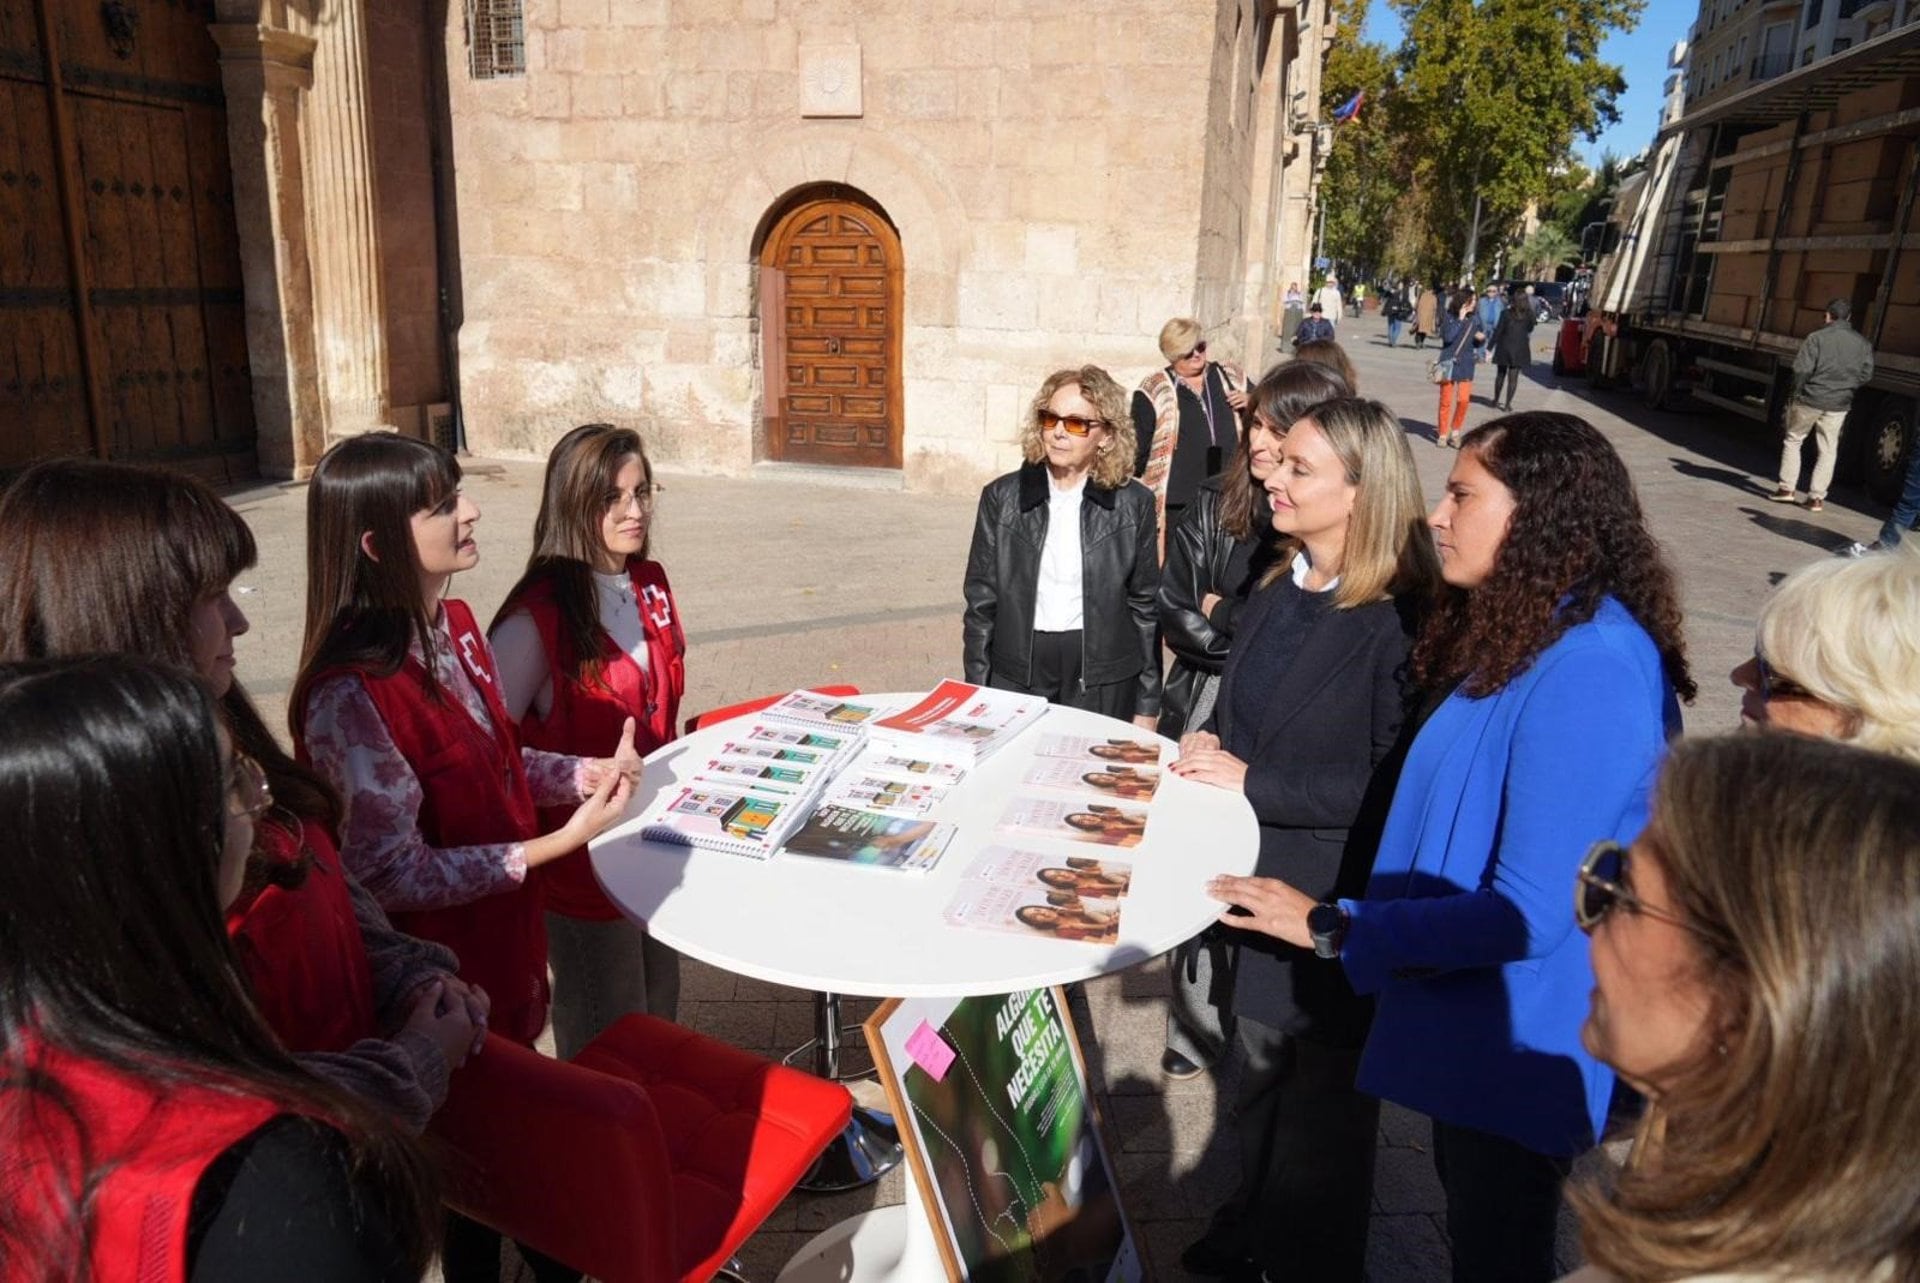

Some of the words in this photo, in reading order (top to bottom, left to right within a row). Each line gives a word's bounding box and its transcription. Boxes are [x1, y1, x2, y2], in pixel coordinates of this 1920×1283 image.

[996, 990, 1034, 1042] ALGU
[1011, 1008, 1038, 1060] QUE
[1033, 988, 1052, 1021] TE
[1006, 1016, 1062, 1110] NECESITA
